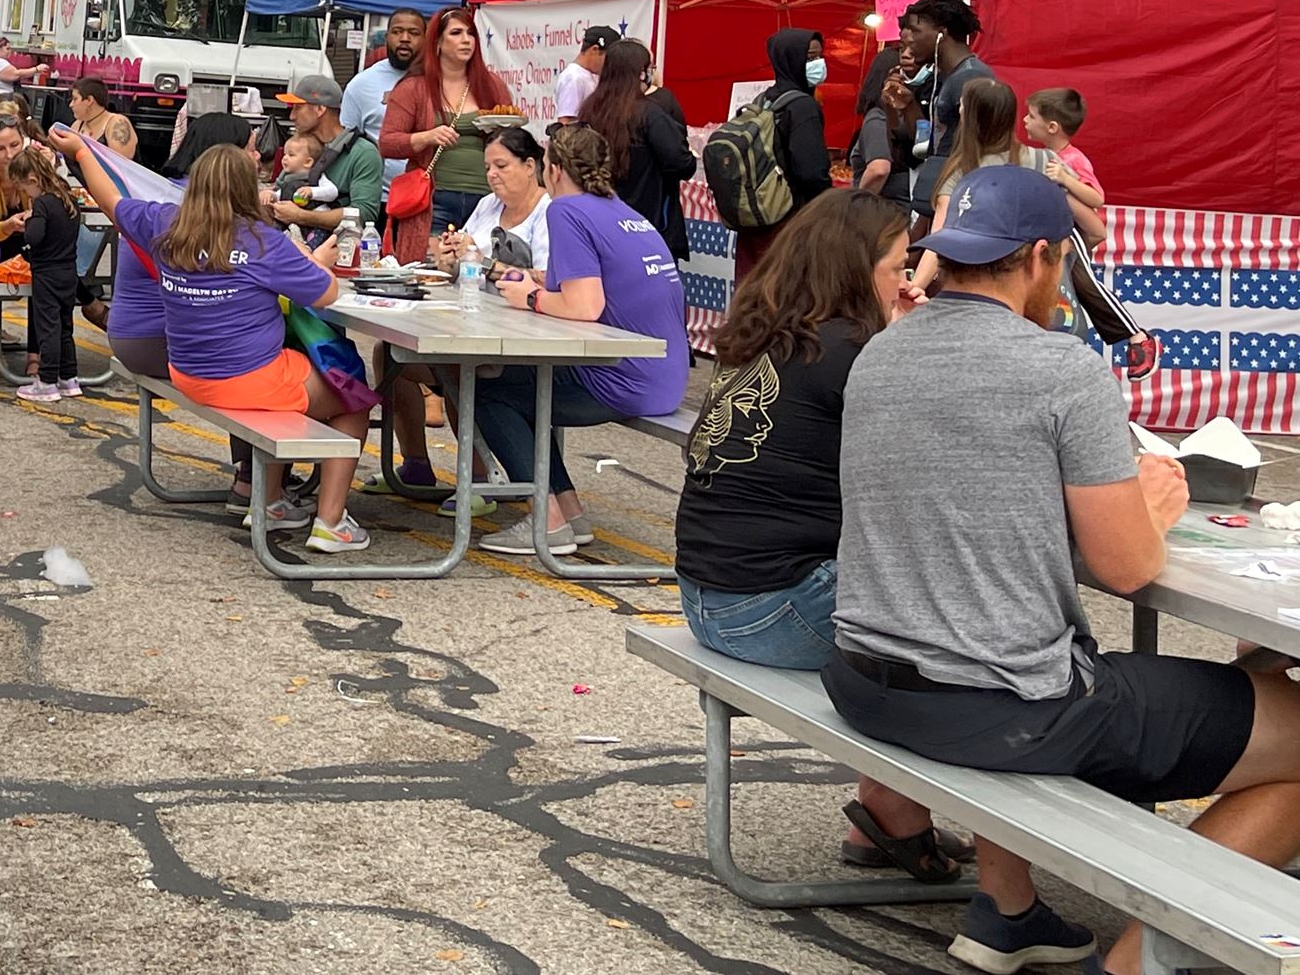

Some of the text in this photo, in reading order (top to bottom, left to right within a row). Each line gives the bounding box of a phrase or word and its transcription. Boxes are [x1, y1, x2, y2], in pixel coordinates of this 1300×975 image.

[506, 27, 535, 51] Kabobs
[544, 22, 573, 47] Funnel
[525, 61, 552, 85] Onion
[520, 96, 540, 121] Pork
